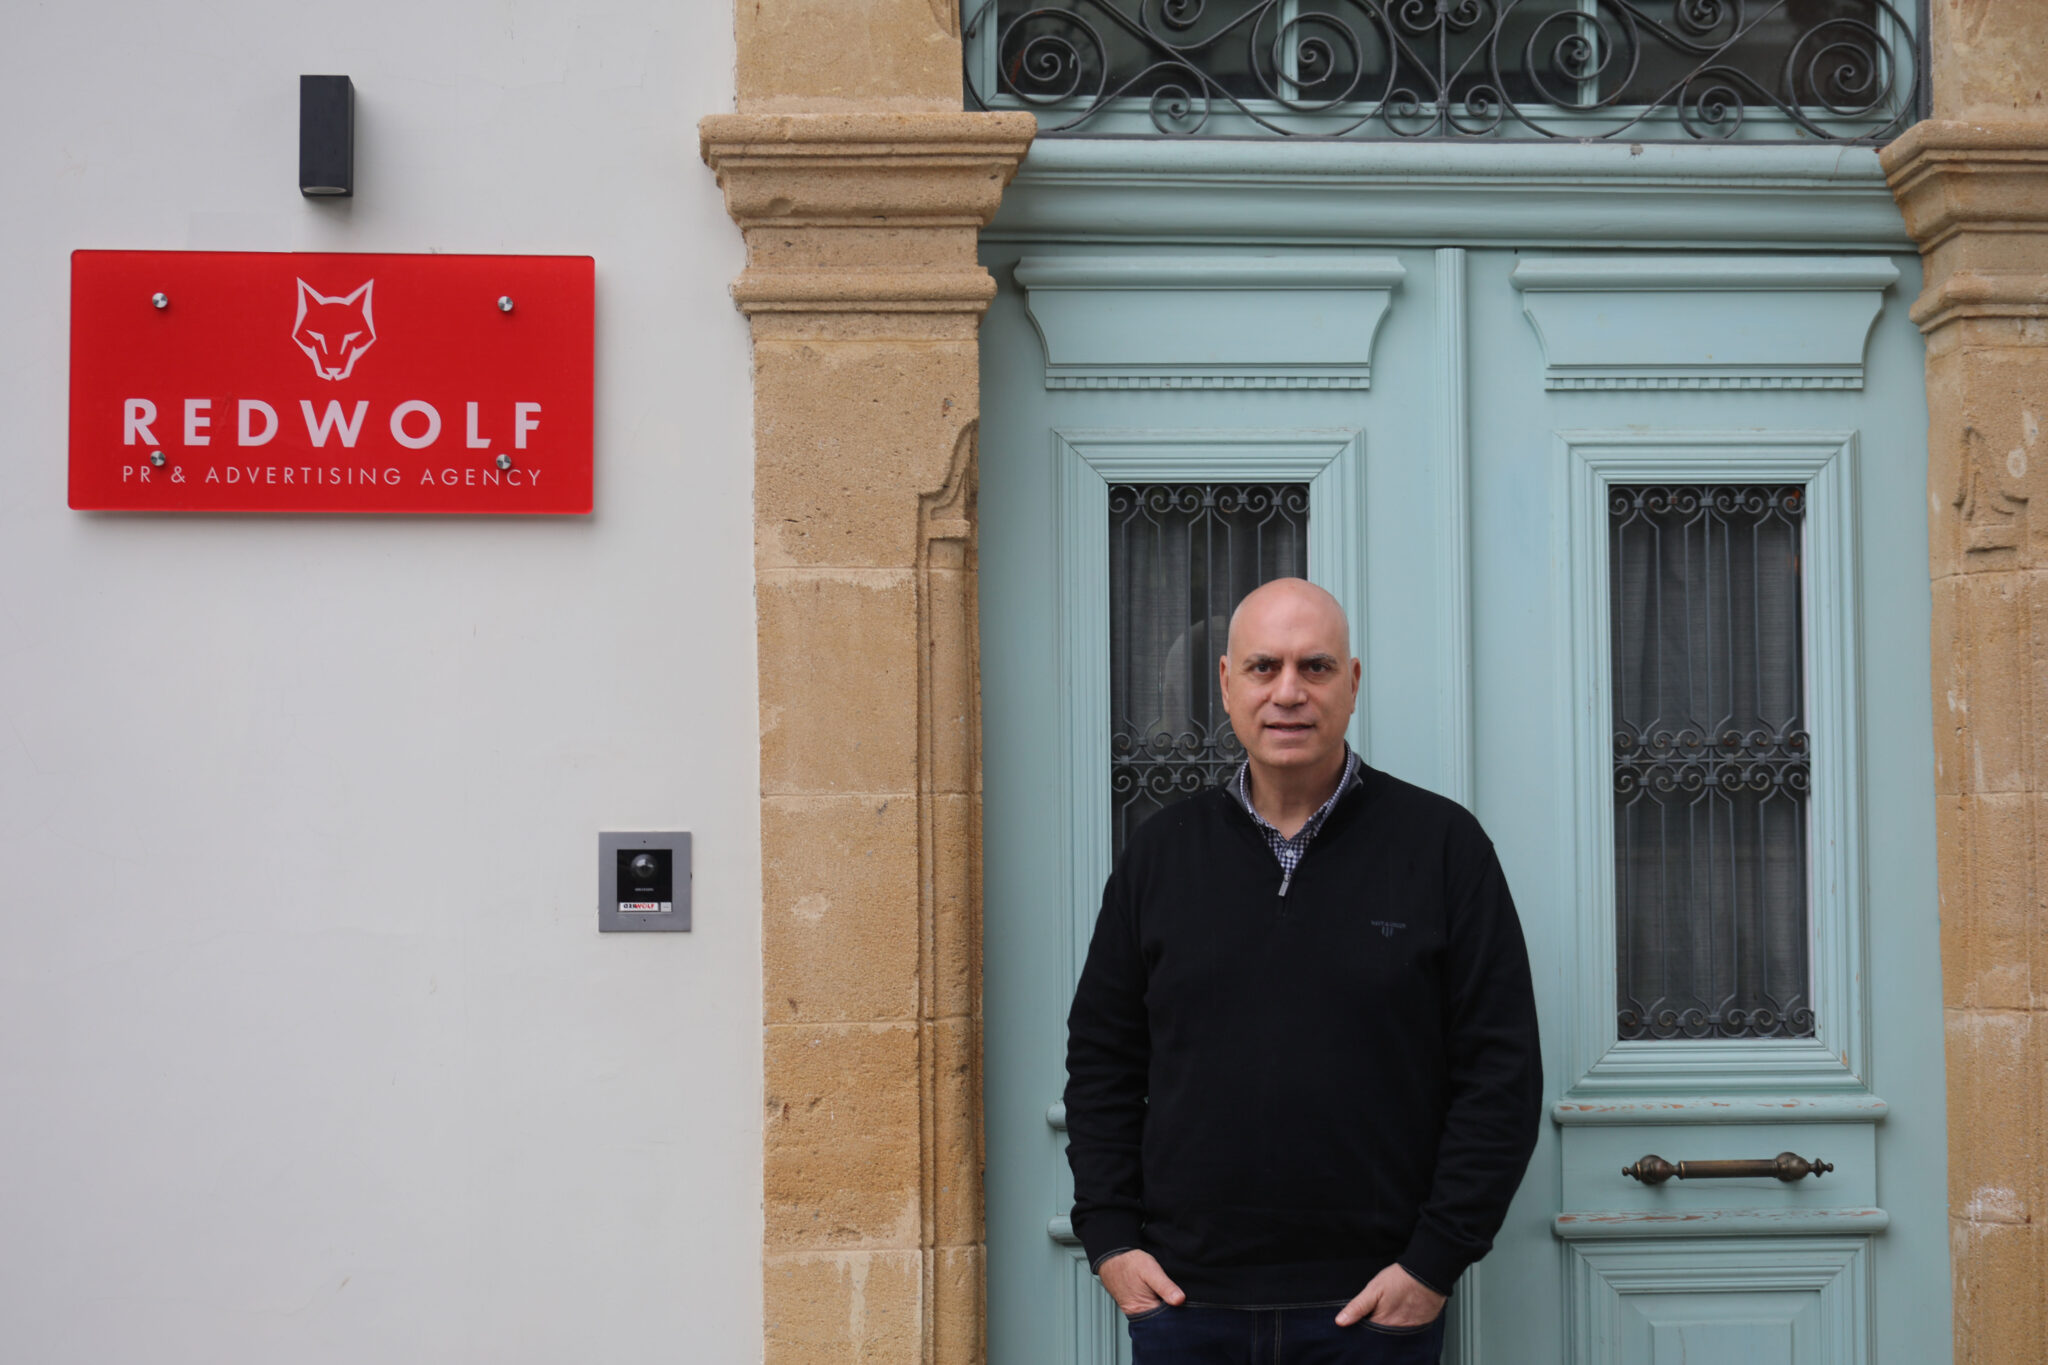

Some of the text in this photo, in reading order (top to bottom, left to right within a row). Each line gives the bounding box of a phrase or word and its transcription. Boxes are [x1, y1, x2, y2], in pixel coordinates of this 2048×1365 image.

[123, 398, 542, 449] REDWOLF
[123, 465, 542, 486] PR & ADVERTISING AGENCY
